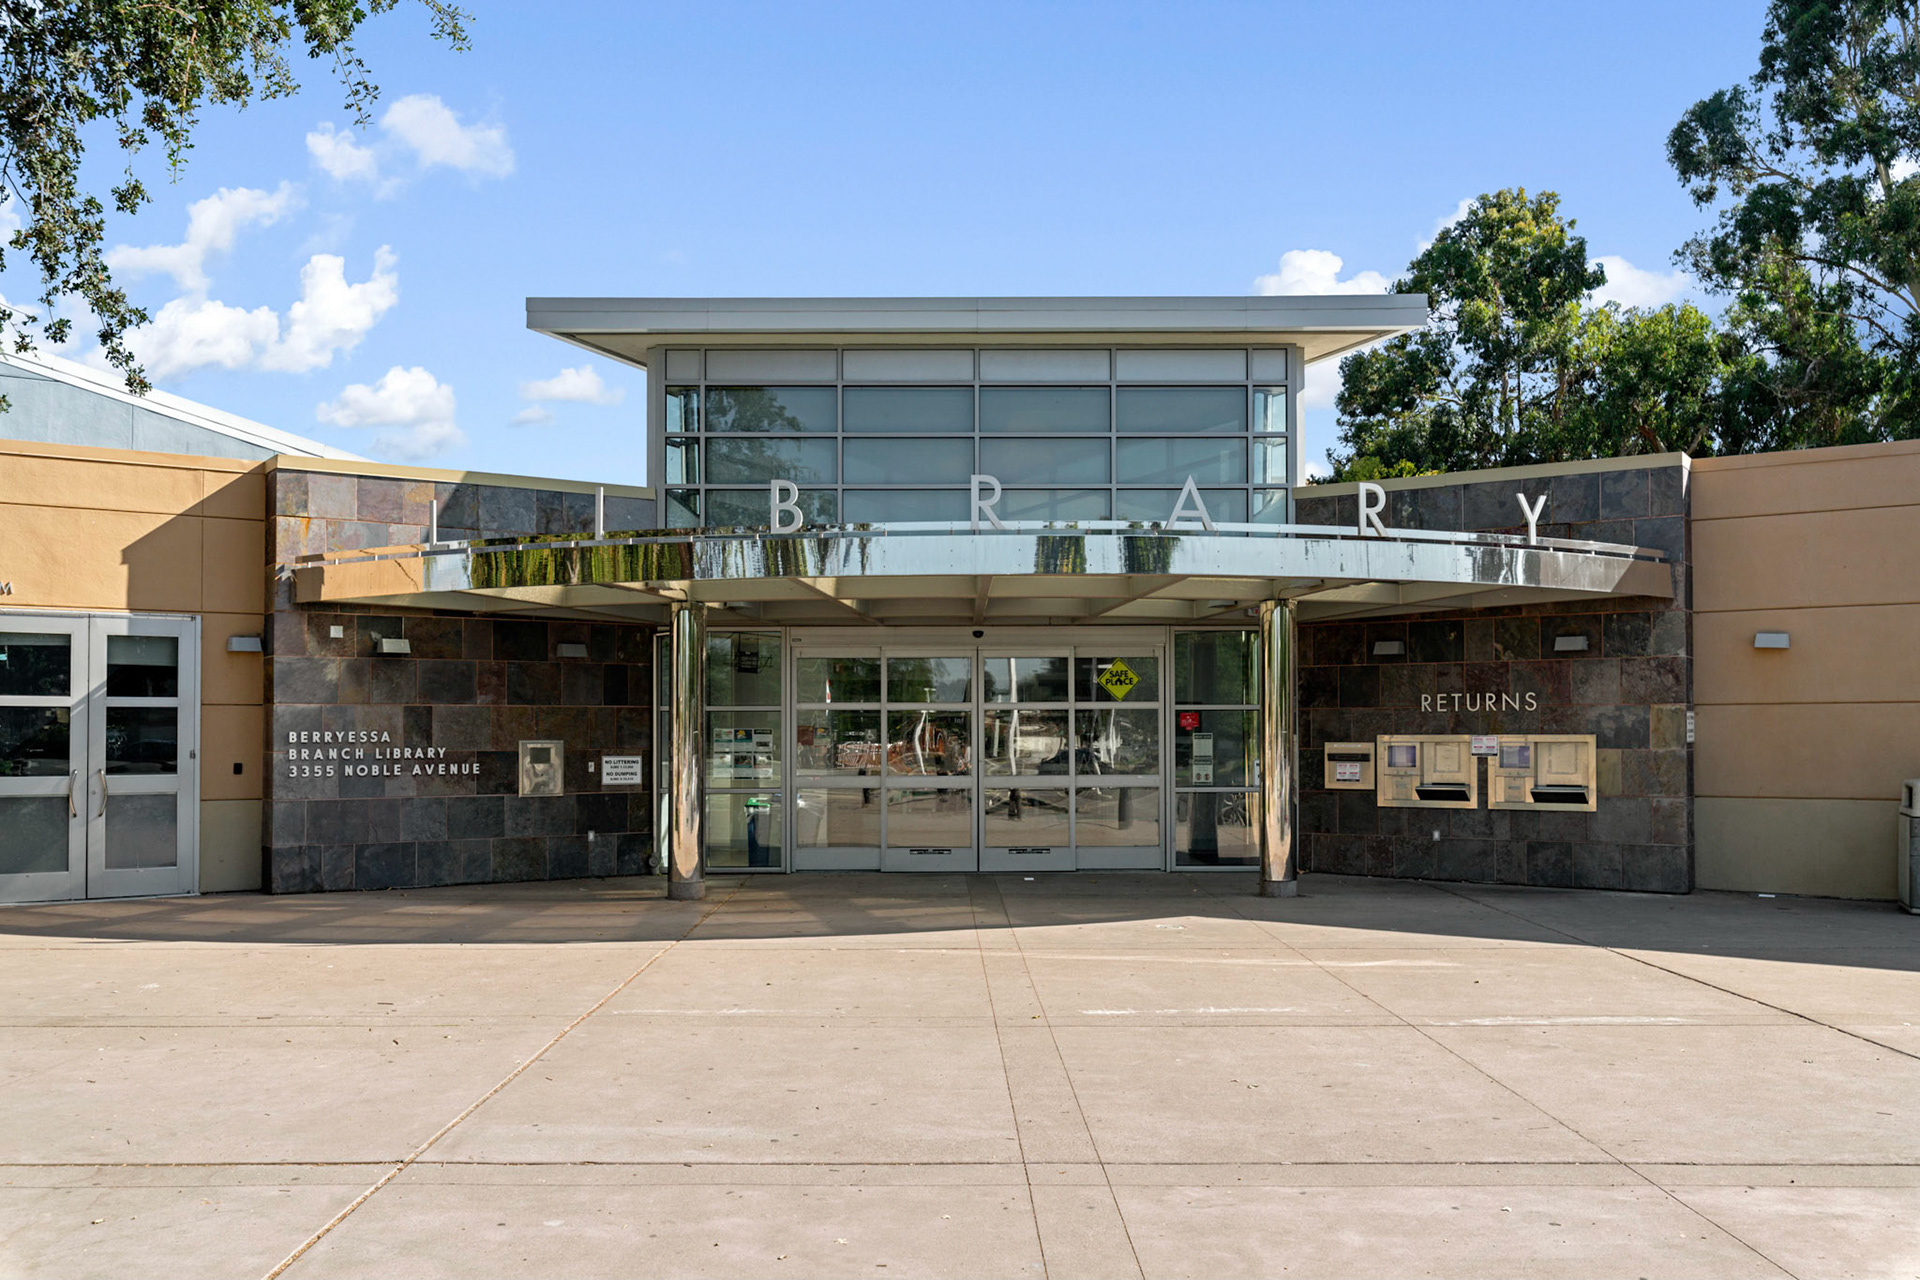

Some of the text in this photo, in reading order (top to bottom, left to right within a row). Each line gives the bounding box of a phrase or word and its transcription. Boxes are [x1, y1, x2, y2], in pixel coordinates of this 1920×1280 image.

[429, 473, 1547, 551] LIBRARY
[1105, 677, 1134, 686] PLACE
[1421, 691, 1538, 712] RETURNS
[289, 731, 390, 743] BERRYESSA
[289, 747, 446, 760] BRANCH LIBRARY
[289, 763, 480, 777] 3355 NOBLE AVENUE
